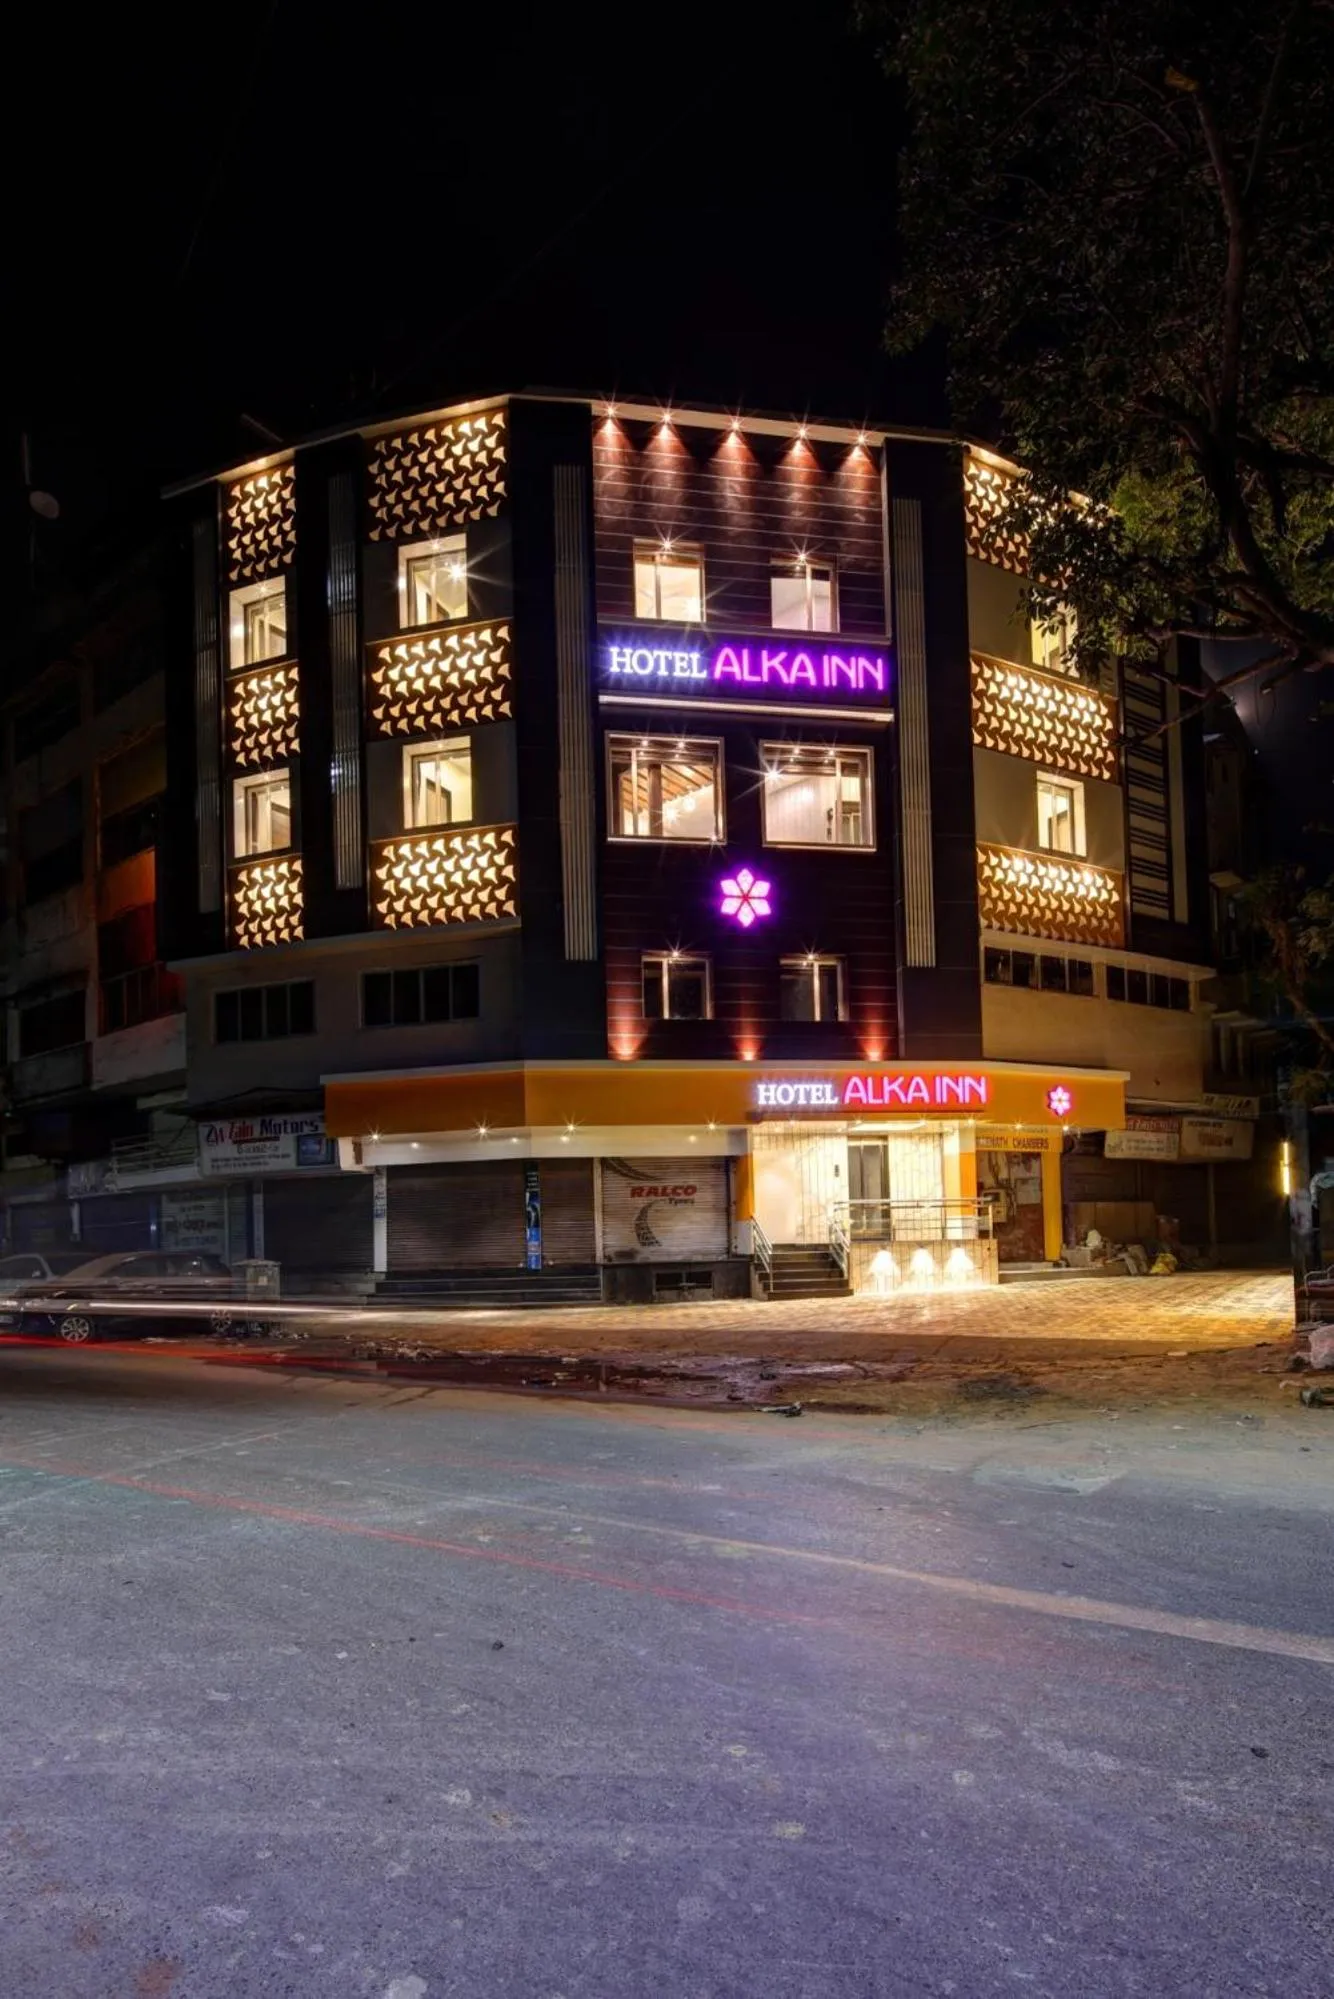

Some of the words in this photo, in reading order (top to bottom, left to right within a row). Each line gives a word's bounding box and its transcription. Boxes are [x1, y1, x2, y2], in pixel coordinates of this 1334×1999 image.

[608, 646, 707, 679] HOTEL
[713, 647, 816, 686] ALKA
[822, 654, 884, 690] INN
[757, 1083, 839, 1105] HOTEL
[844, 1075, 930, 1105] ALKA
[935, 1075, 987, 1105] INN
[259, 1118, 320, 1137] Motors
[630, 1185, 698, 1199] RALCO
